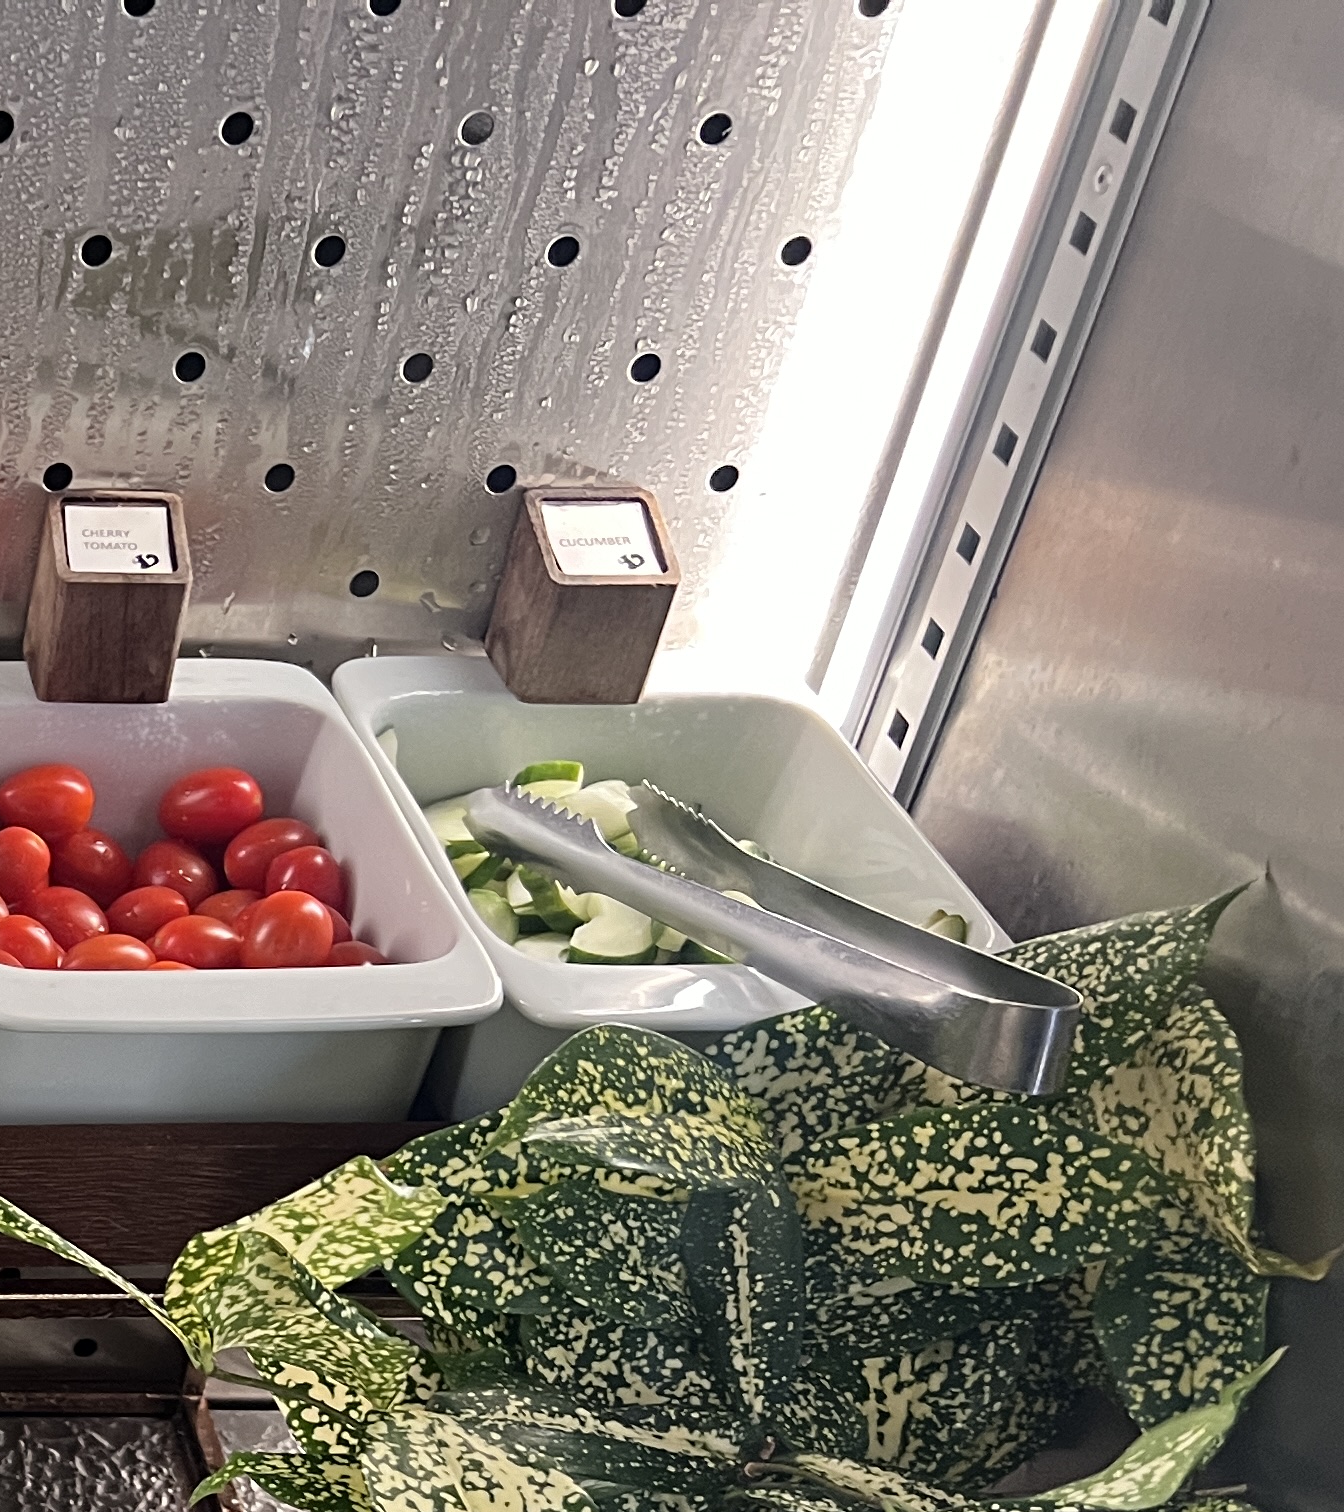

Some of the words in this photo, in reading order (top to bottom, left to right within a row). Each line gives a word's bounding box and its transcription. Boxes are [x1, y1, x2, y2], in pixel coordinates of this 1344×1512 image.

[81, 528, 130, 538] CHERRY
[83, 541, 138, 551] TOMATO
[559, 536, 631, 547] CUCUMBER
